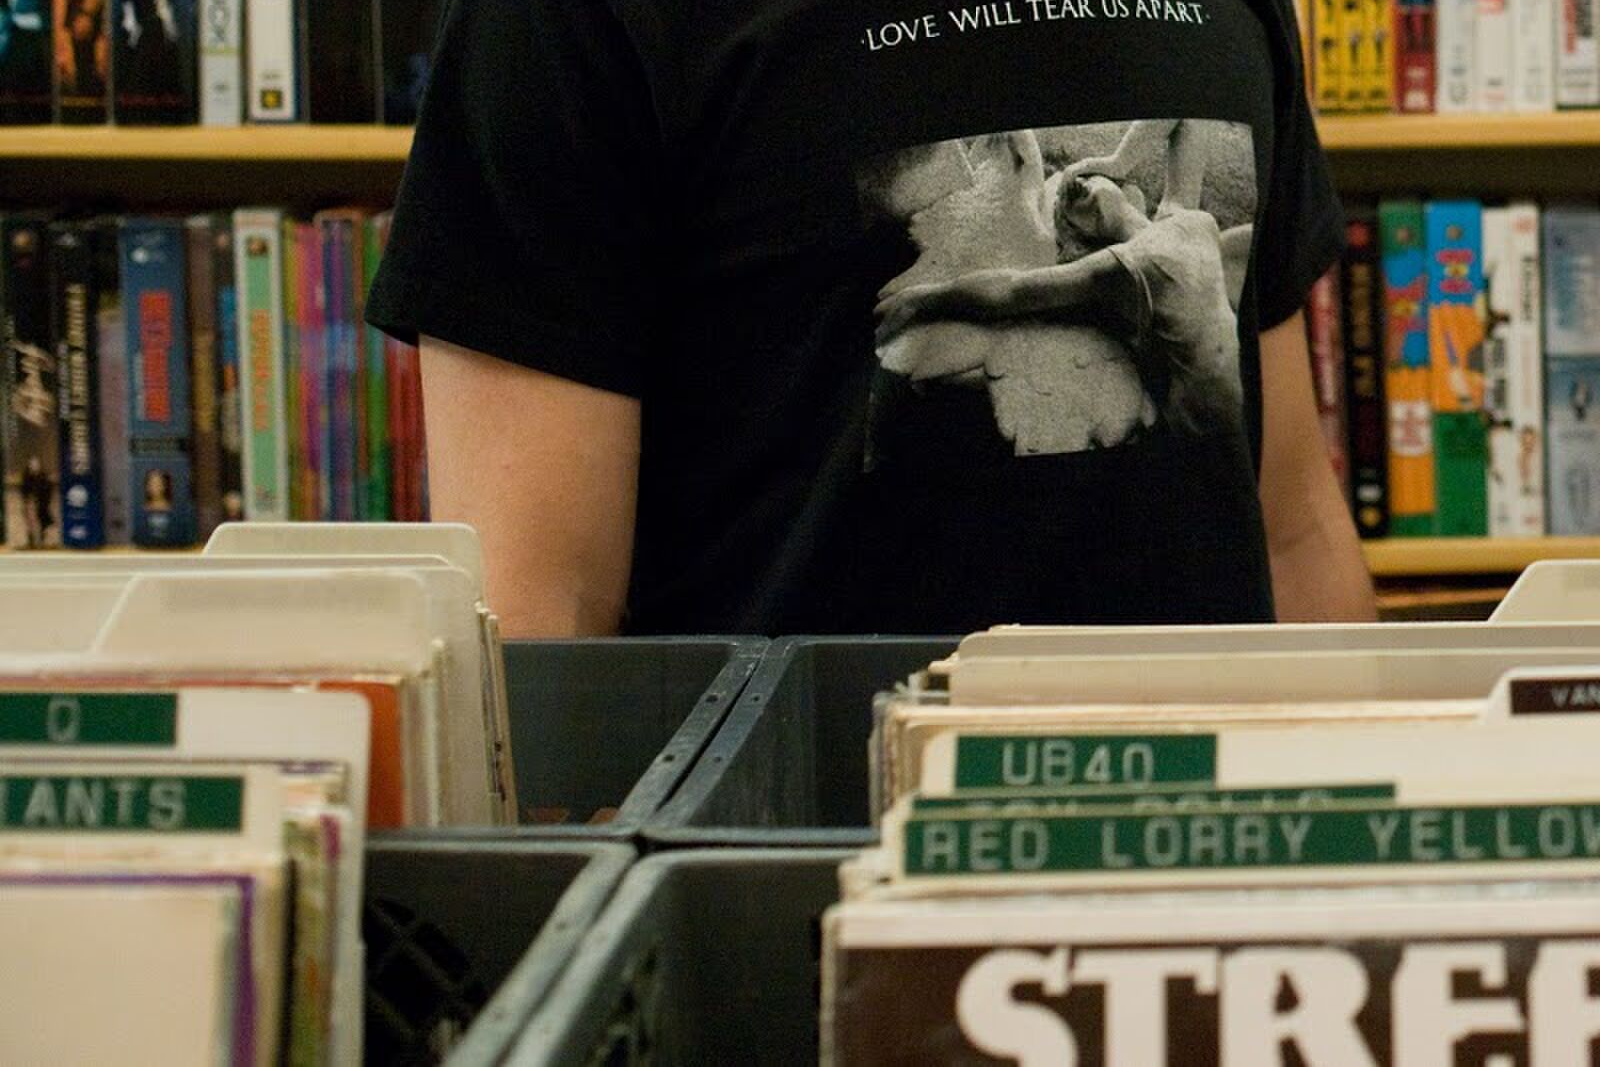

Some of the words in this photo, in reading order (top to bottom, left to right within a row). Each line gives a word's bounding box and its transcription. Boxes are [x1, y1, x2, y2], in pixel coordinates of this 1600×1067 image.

[866, 14, 941, 51] LOVE
[948, 1, 1022, 33] WILL
[1002, 739, 1156, 788] UB40
[921, 818, 1051, 872] RED
[1100, 813, 1314, 869] LORRY
